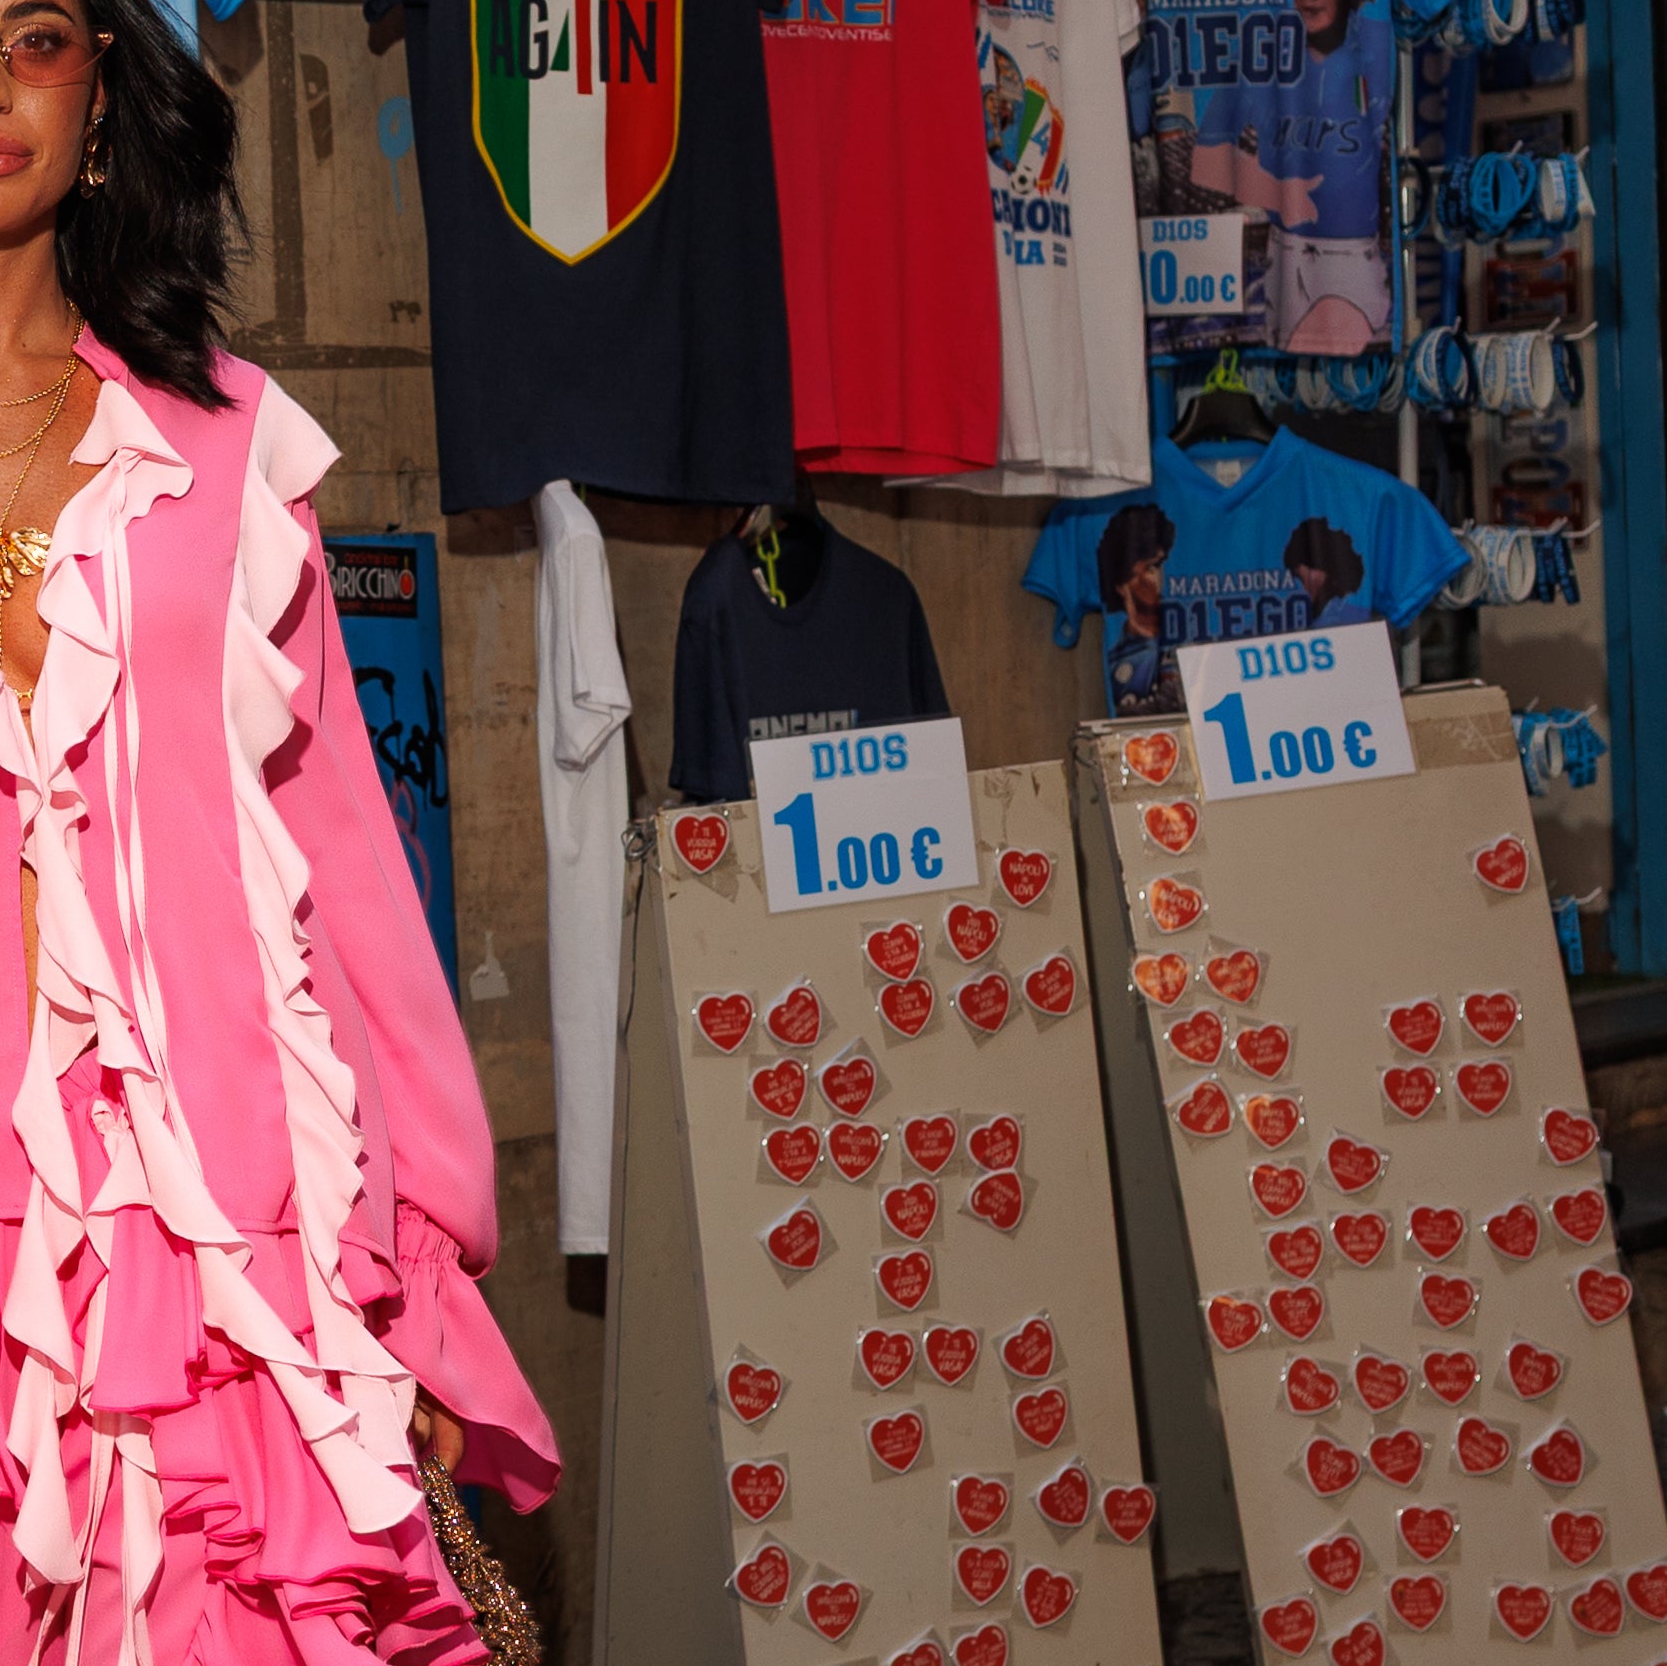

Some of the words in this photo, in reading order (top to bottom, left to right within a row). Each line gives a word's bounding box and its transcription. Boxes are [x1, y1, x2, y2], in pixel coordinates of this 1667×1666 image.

[1168, 568, 1297, 598] MARADONA
[1203, 692, 1335, 786] 1.00
[773, 792, 902, 896] 1.00
